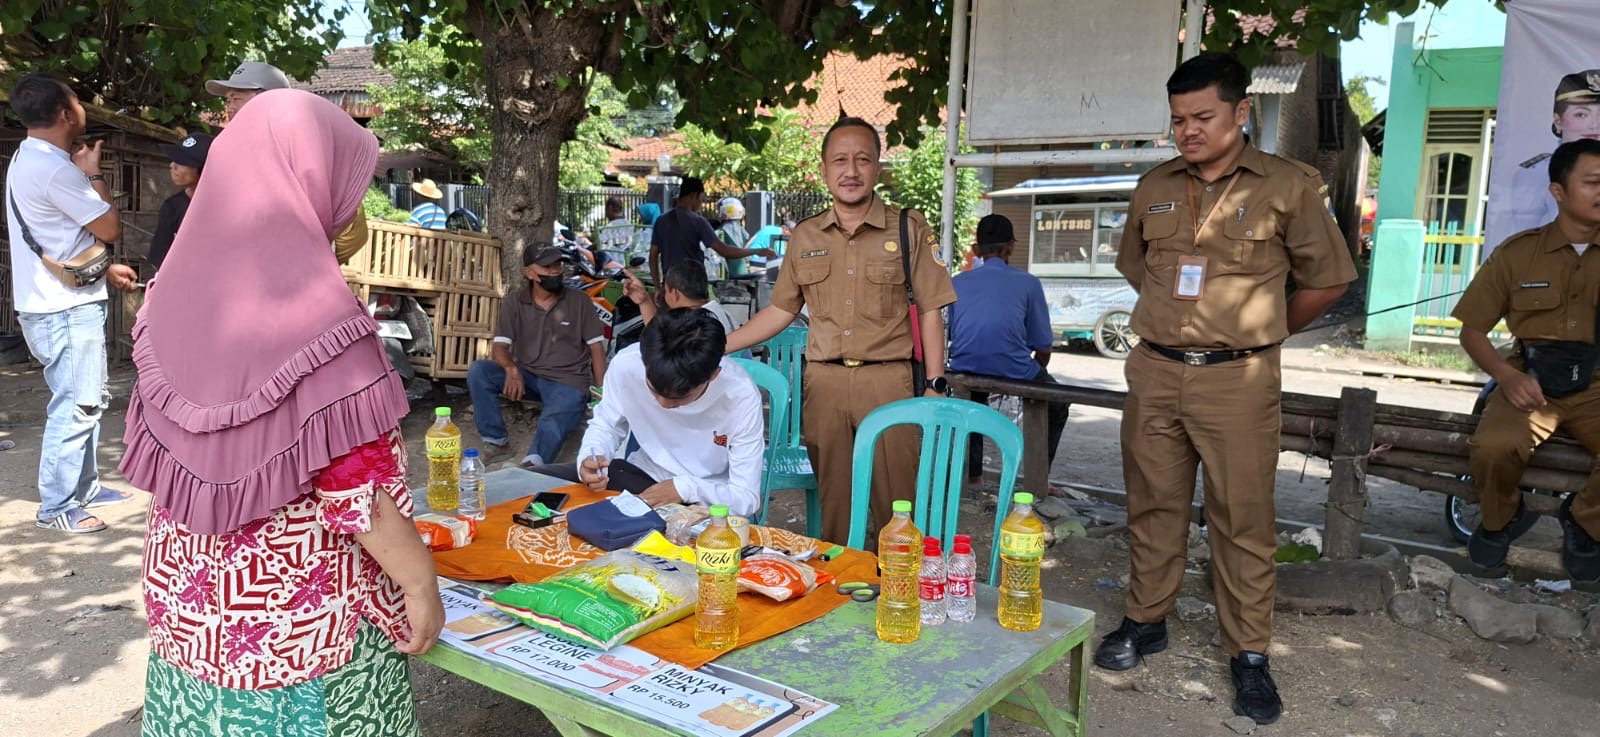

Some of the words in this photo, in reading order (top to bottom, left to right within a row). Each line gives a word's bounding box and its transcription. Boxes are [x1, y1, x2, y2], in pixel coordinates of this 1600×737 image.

[699, 551, 731, 568] Rizki
[506, 645, 532, 655] RP
[529, 653, 577, 672] 17.000
[528, 637, 596, 662] LEGINE
[650, 674, 706, 696] RIZKY
[664, 667, 733, 695] MINYAK
[626, 684, 649, 694] RP
[649, 692, 691, 709] 15.500
